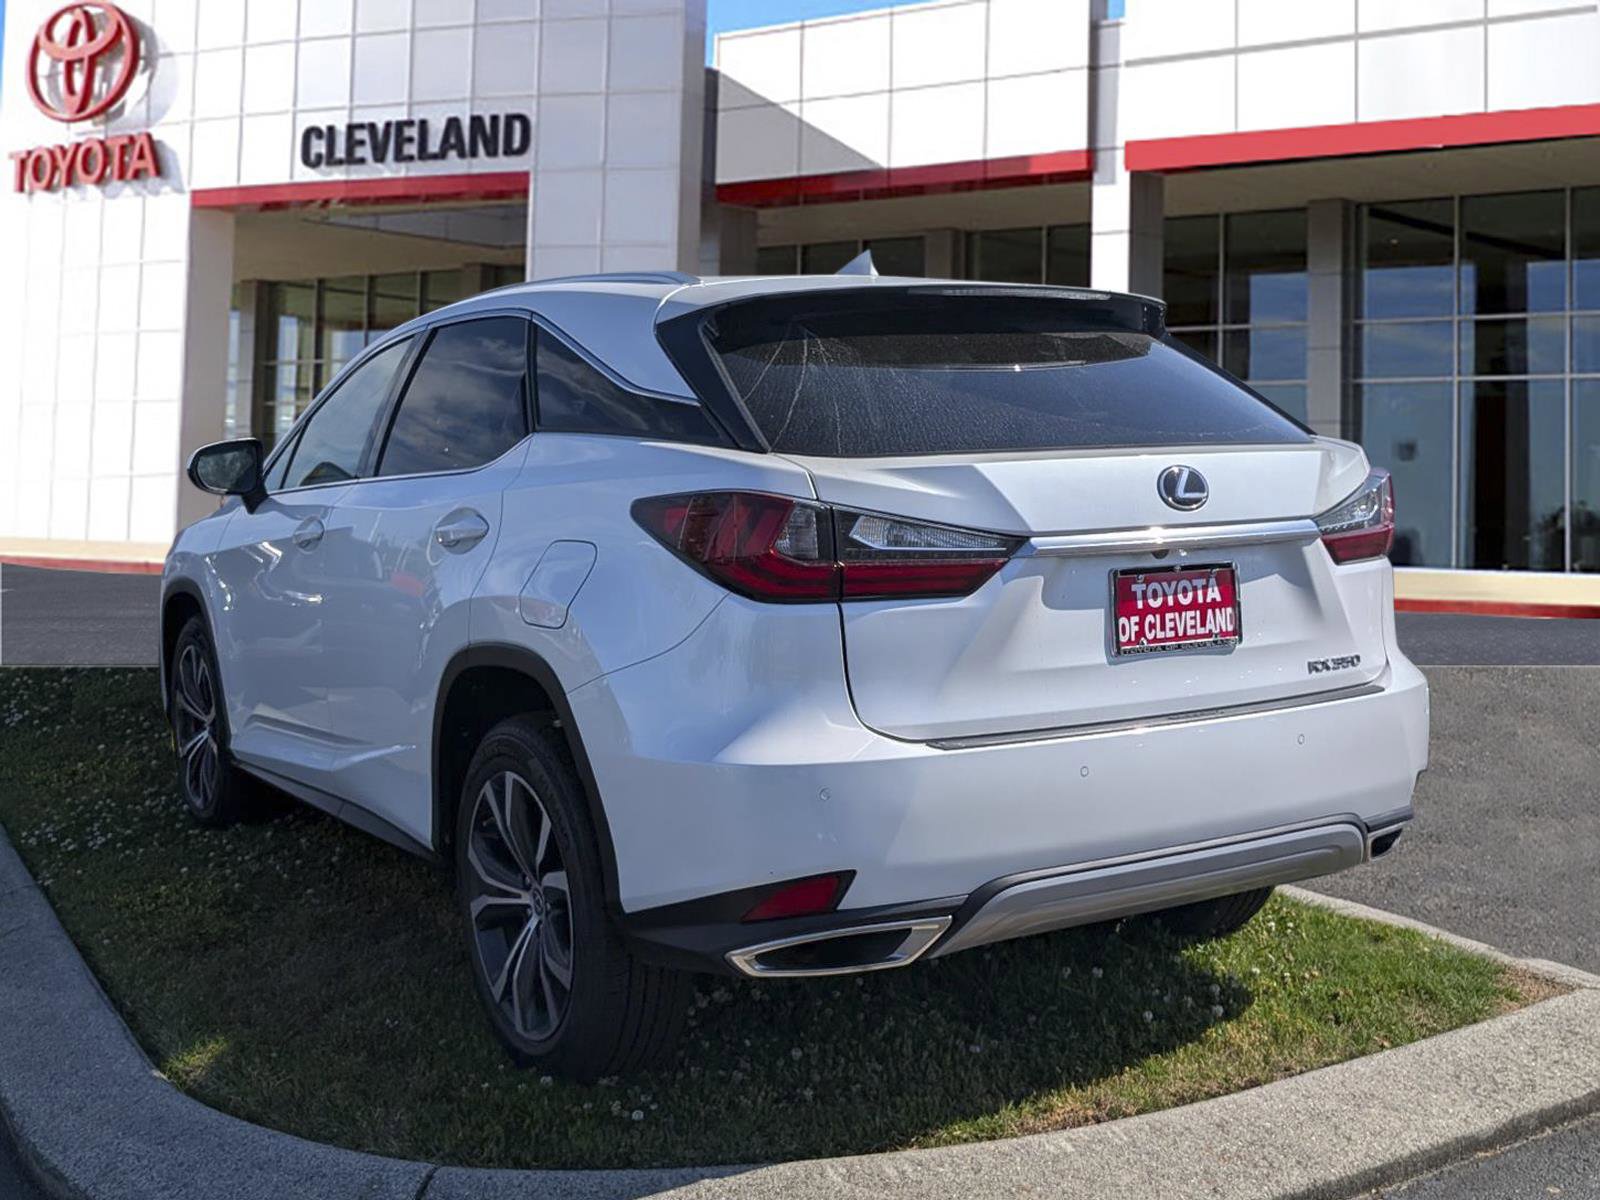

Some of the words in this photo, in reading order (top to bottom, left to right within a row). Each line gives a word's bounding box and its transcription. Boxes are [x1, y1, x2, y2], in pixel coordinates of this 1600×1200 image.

[9, 131, 161, 193] TOYOTA
[301, 113, 531, 169] CLEVELAND
[1131, 578, 1222, 609] TOYOTA
[1119, 615, 1140, 642] OF
[1144, 606, 1235, 641] CLEVELAND
